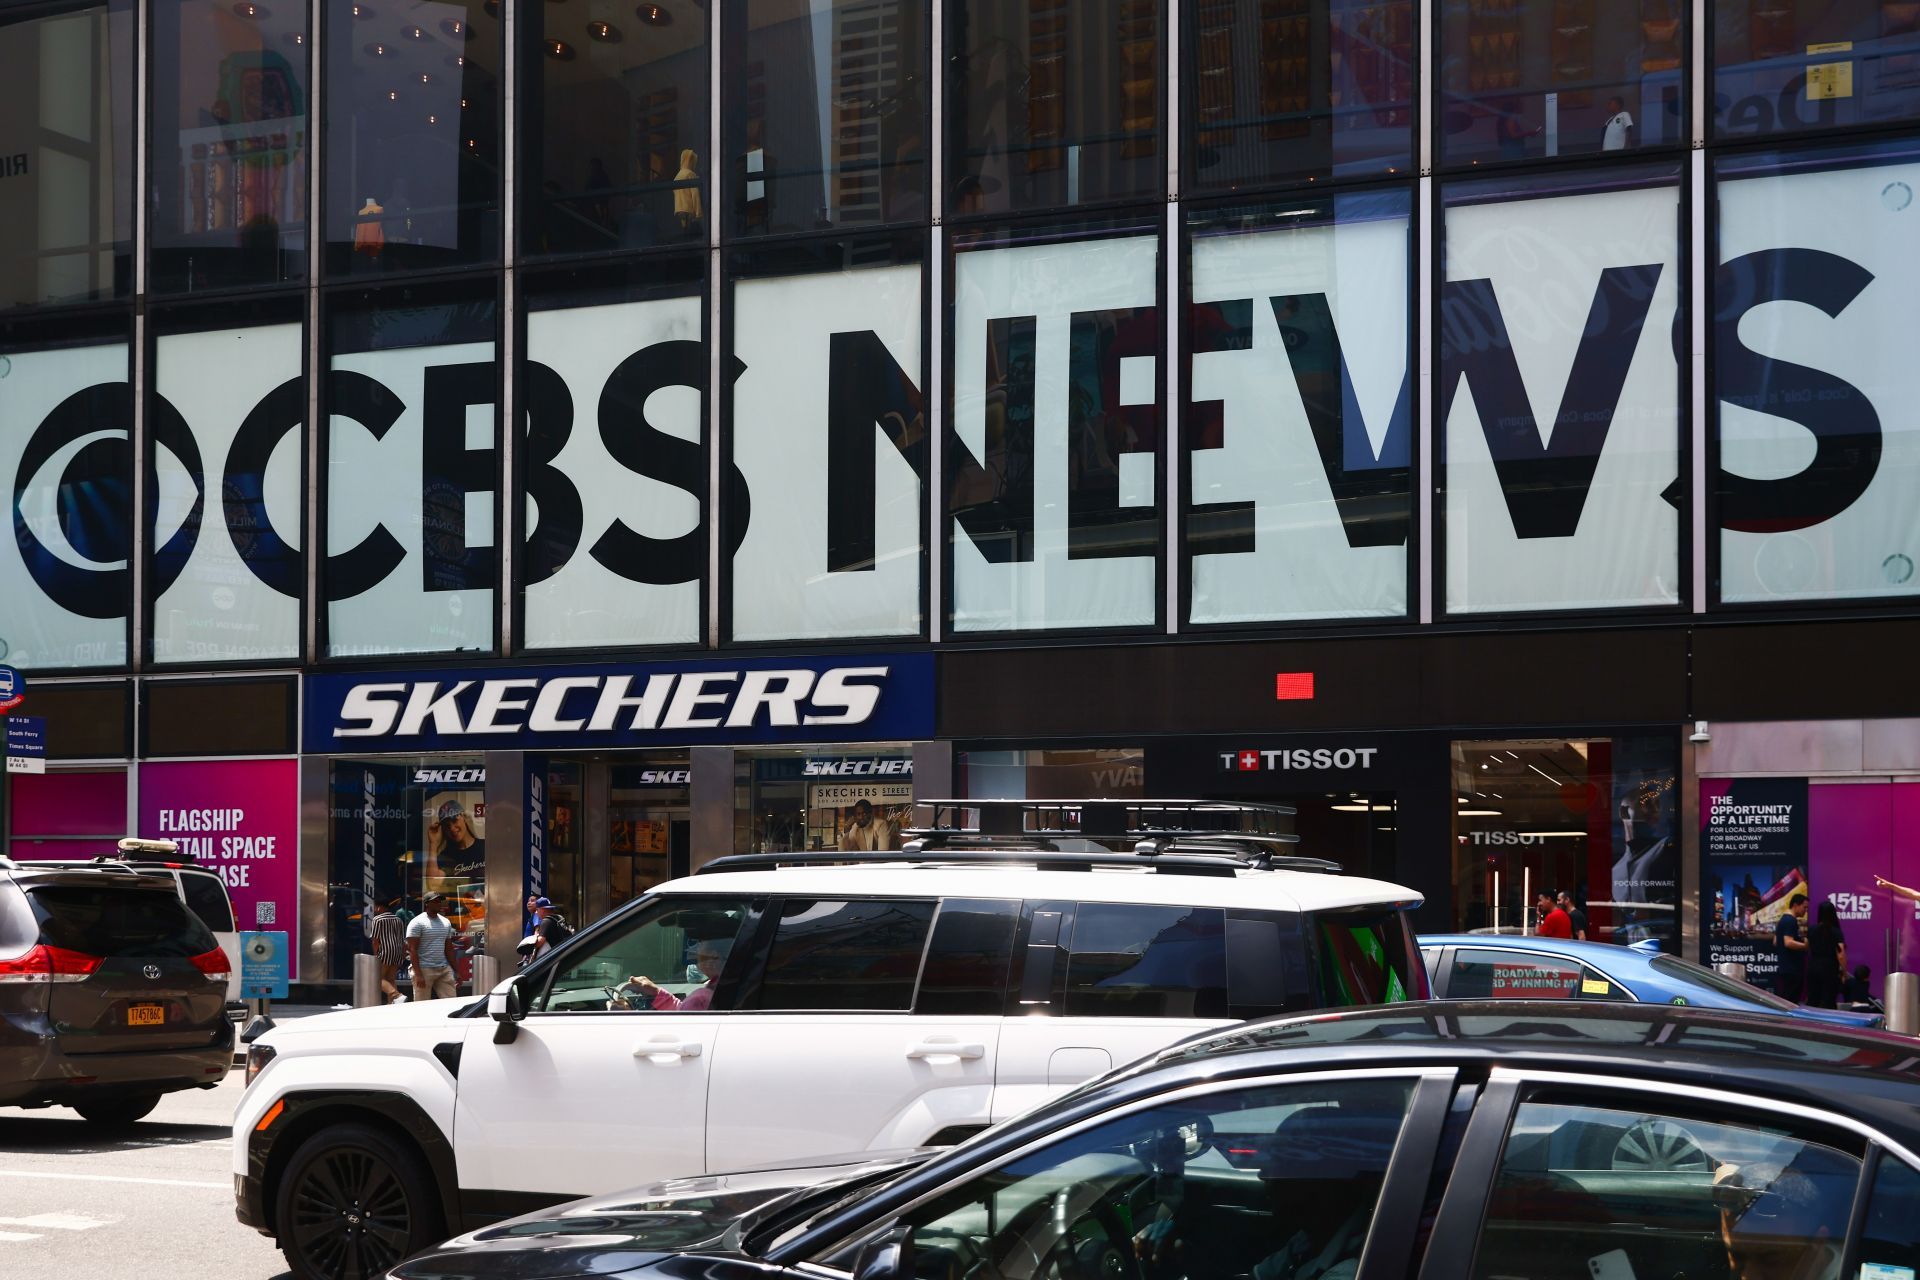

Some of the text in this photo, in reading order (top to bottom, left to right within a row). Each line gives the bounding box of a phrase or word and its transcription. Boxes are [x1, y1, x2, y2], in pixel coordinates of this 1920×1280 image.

[222, 247, 1882, 602] CBS NEWS
[332, 666, 889, 737] SKECHERS
[1260, 748, 1377, 770] TISSOT
[818, 788, 877, 797] SKECHERS
[1710, 796, 1733, 804] THE
[1710, 805, 1792, 814] OPPORTUNITY
[160, 809, 244, 831] FLAGSHIP
[1710, 815, 1790, 824] OF A LIFETIME
[531, 773, 542, 897] SKECH
[221, 836, 276, 859] SPACE
[1711, 953, 1755, 962] Caesars
[131, 1008, 161, 1021] T745786C
